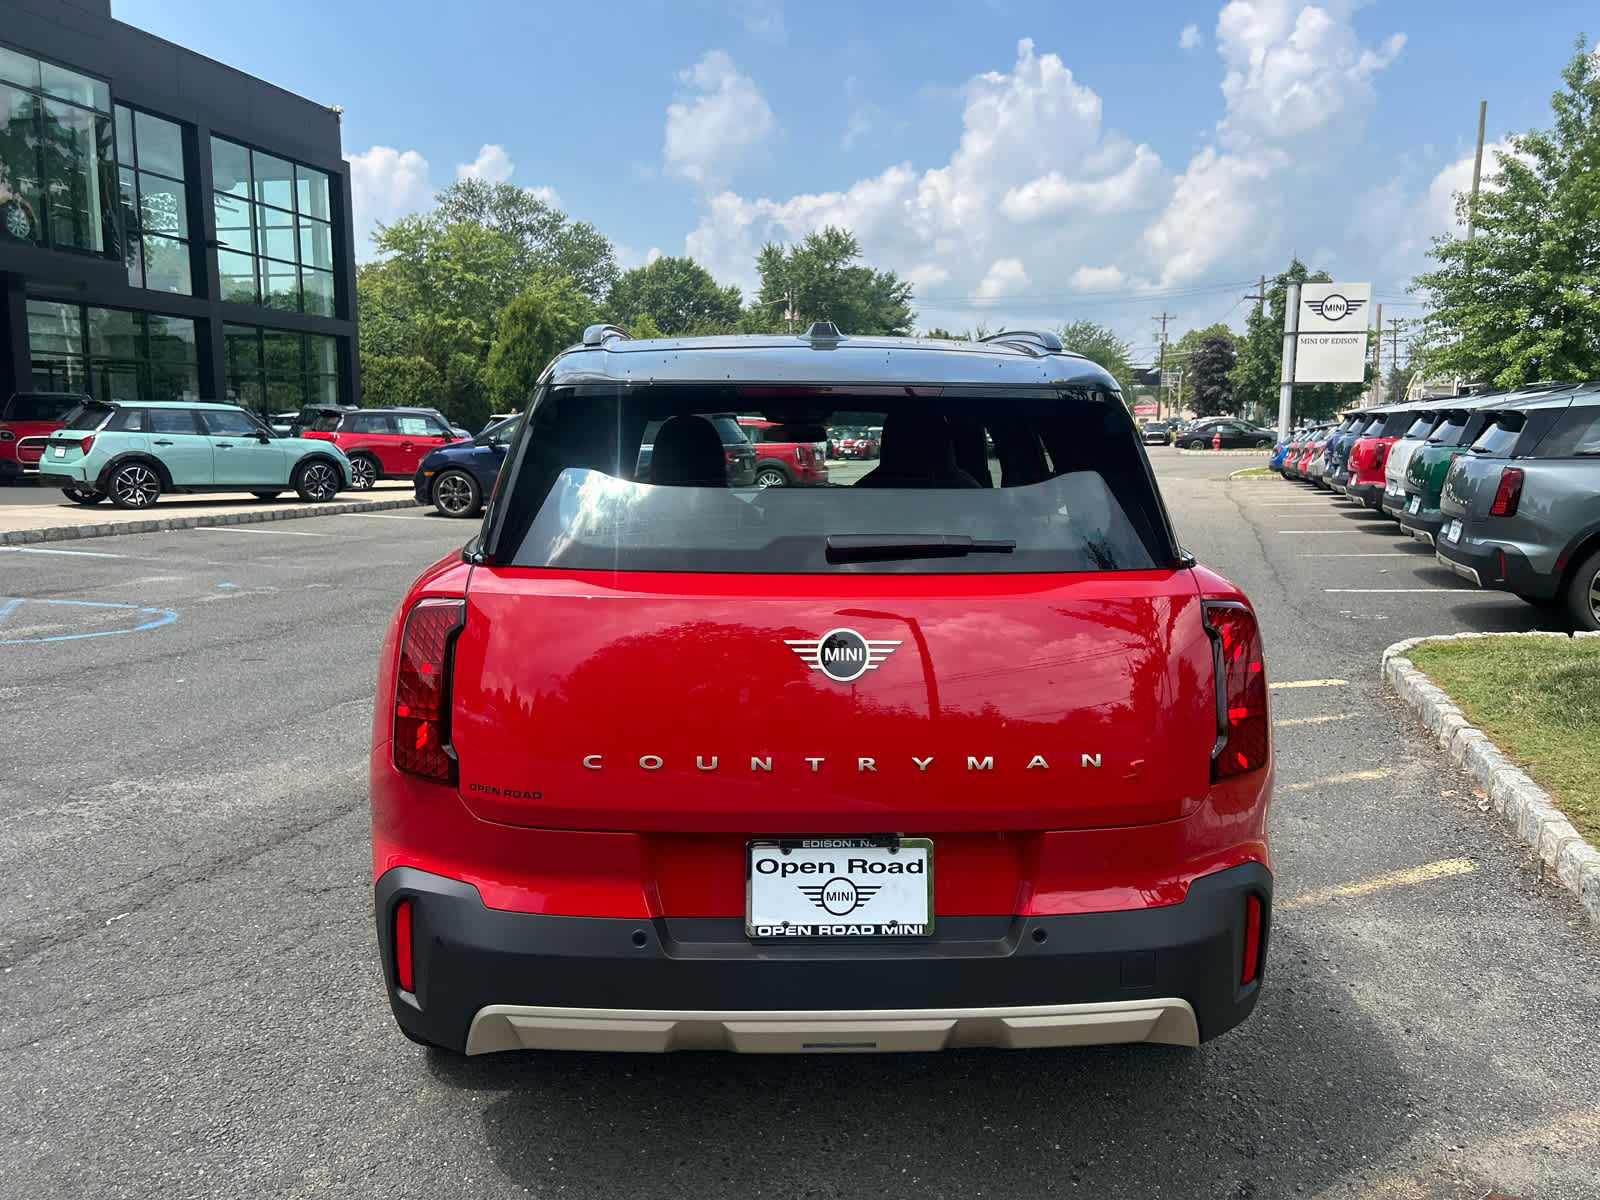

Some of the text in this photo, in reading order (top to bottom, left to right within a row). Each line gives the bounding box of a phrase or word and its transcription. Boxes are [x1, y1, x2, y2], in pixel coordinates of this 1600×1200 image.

[1324, 304, 1345, 312] MINI
[1331, 337, 1359, 345] EDISON
[824, 647, 863, 661] MINI
[583, 753, 1102, 772] COUNTRYMAN
[469, 783, 543, 799] OPEN ROAD
[756, 858, 924, 878] Open Road
[825, 890, 854, 902] MINI
[757, 924, 923, 936] OPEN ROAD MINI
